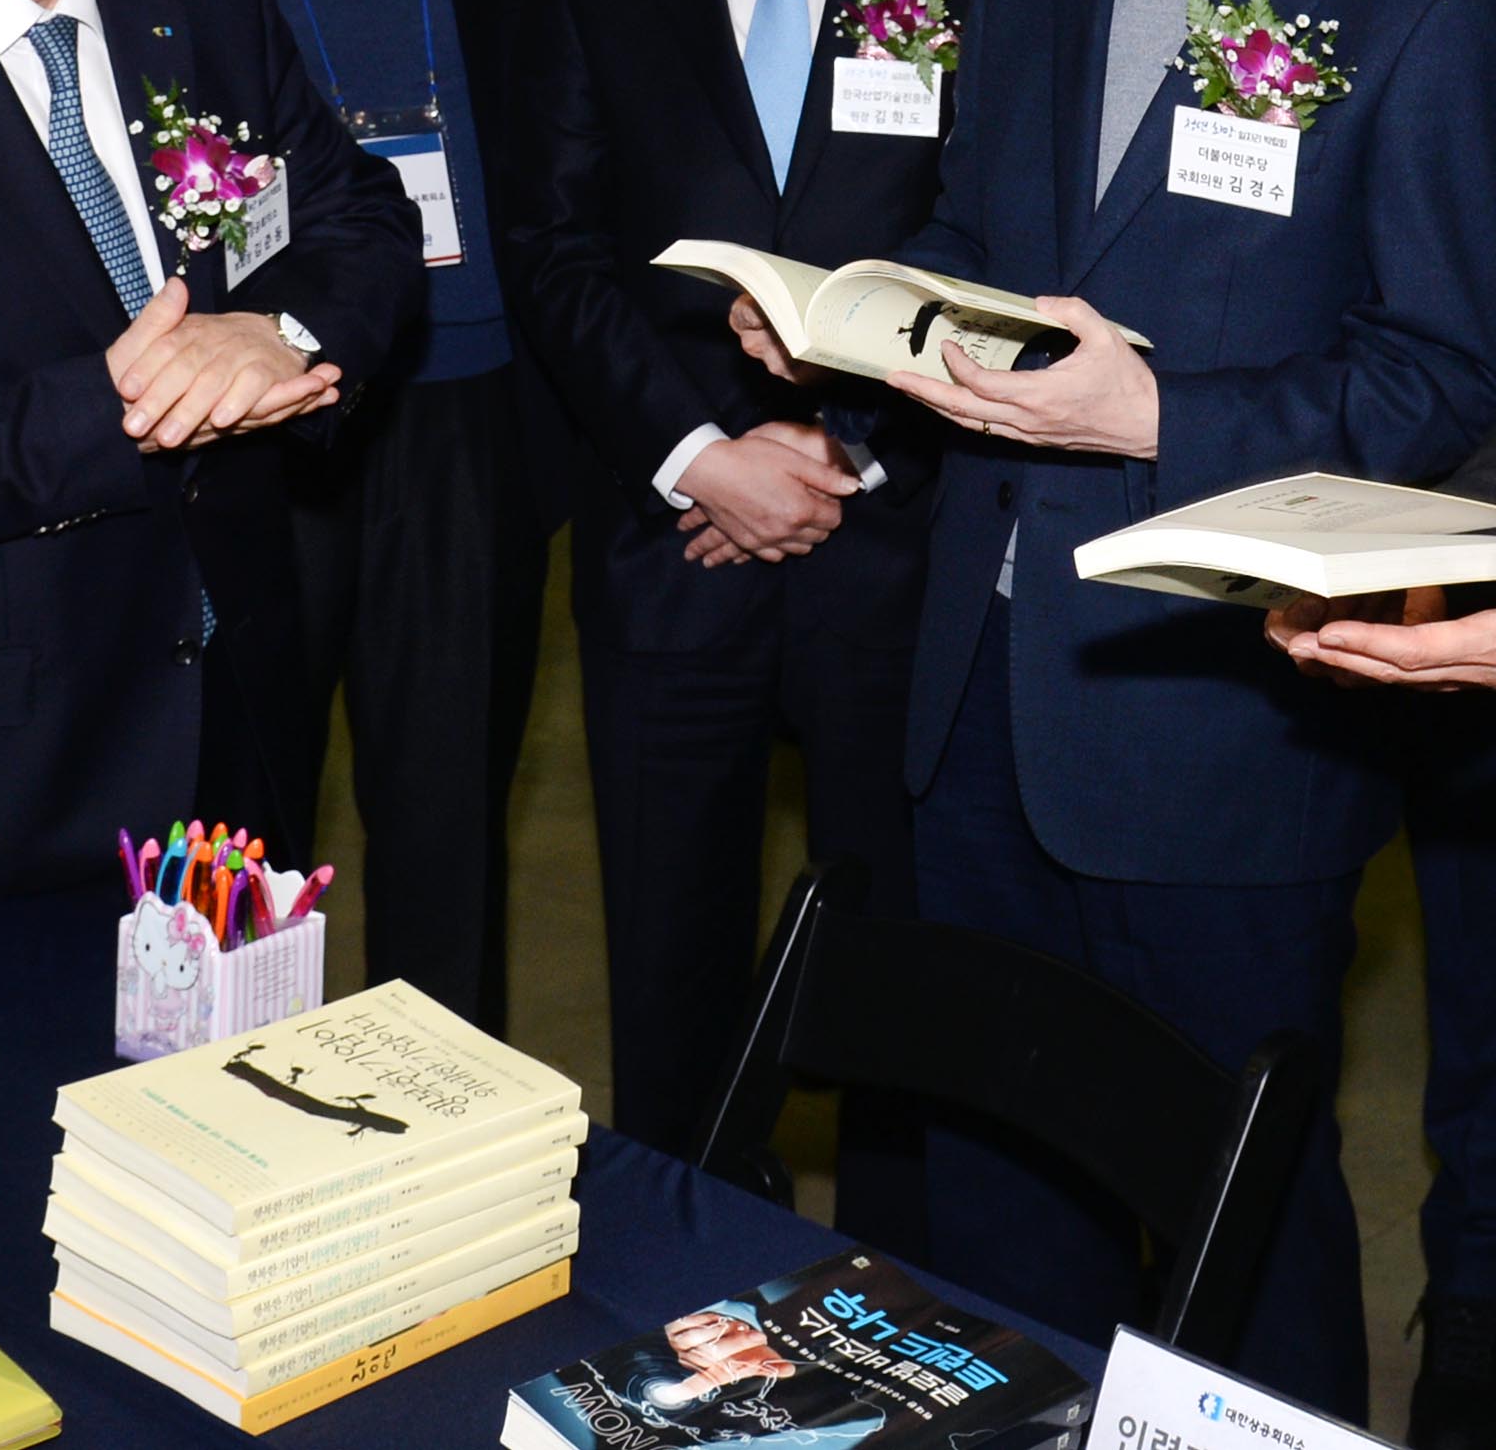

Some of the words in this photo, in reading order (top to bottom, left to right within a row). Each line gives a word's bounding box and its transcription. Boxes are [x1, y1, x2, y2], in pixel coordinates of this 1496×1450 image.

[1176, 168, 1223, 190] 국회의원
[1198, 146, 1268, 172] 더불어민주당
[297, 1019, 399, 1075] 기업이
[799, 1307, 891, 1369] 비즈니스
[823, 1288, 900, 1342] 나우
[883, 1359, 970, 1408] 글로벌
[889, 1331, 1009, 1392] 트렌드
